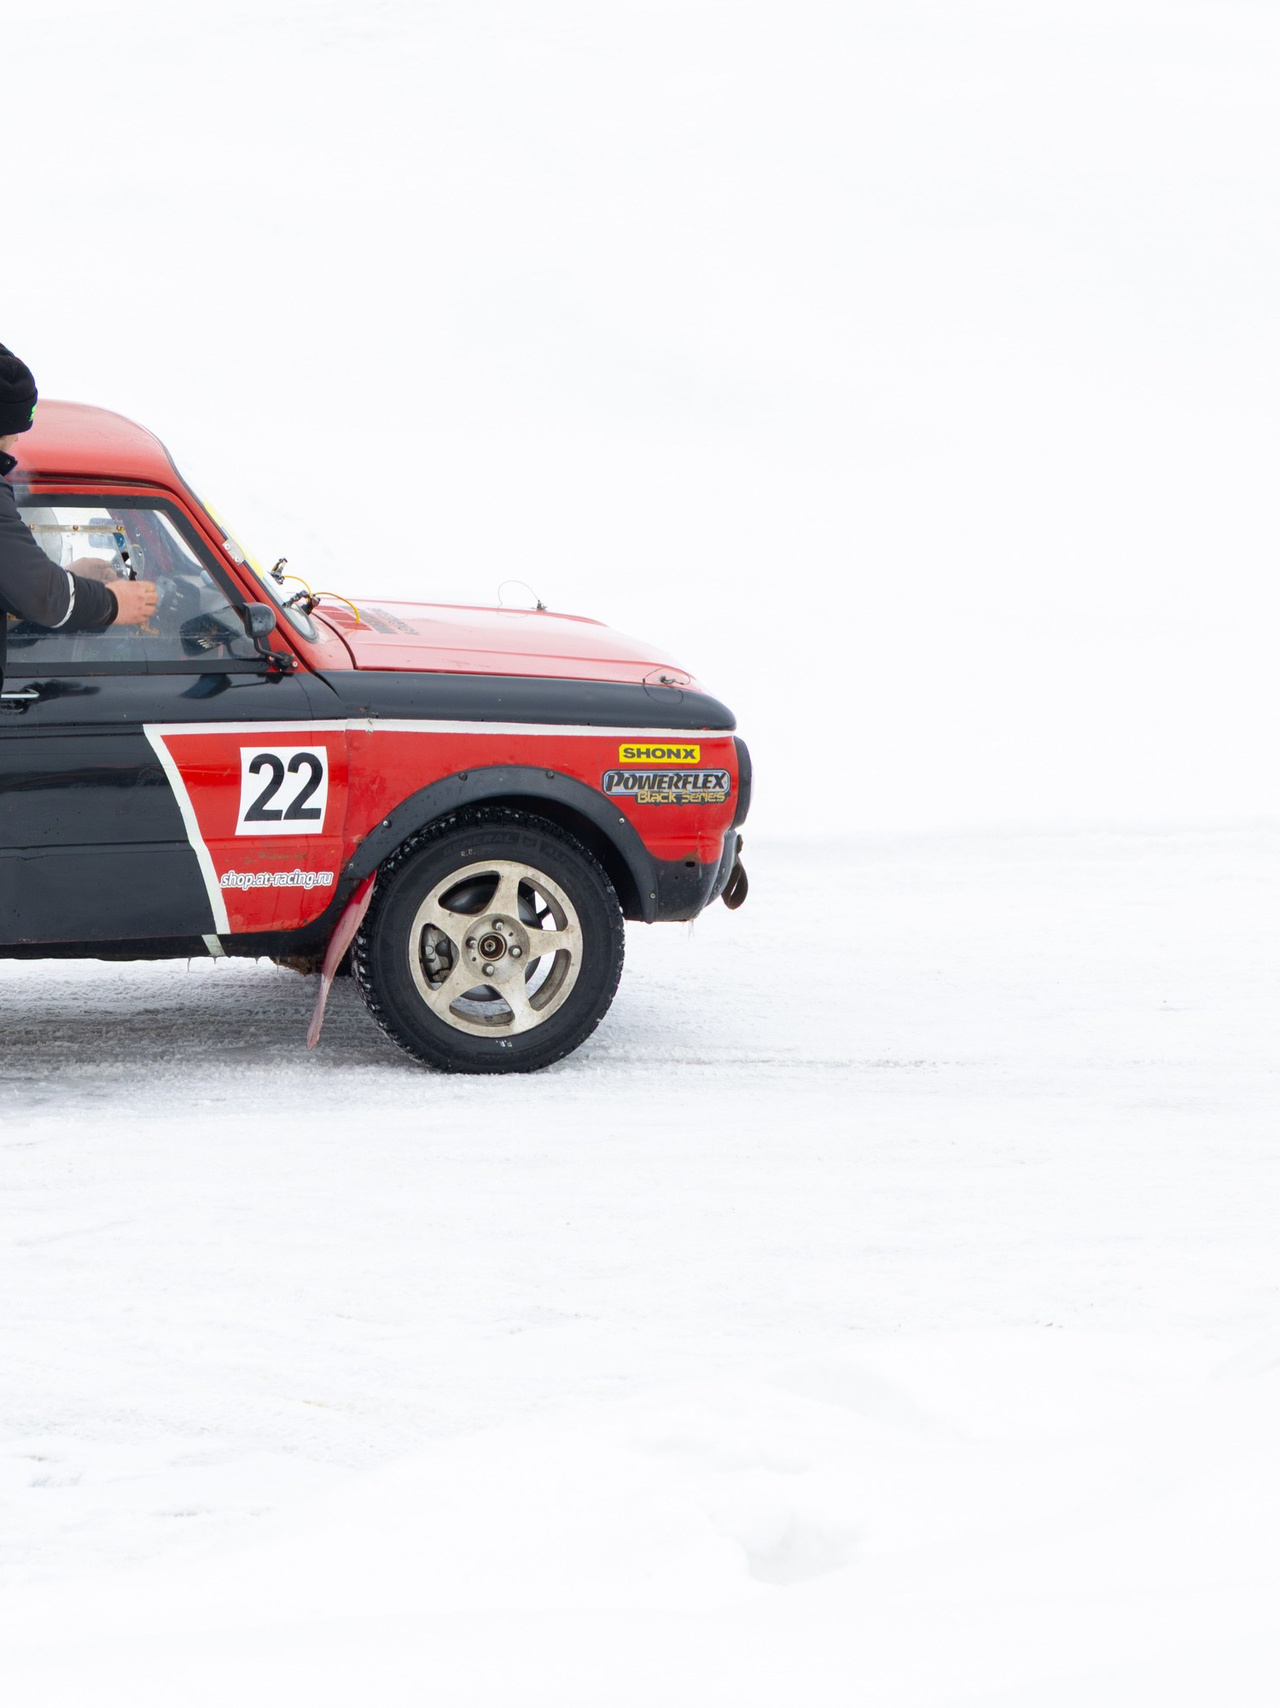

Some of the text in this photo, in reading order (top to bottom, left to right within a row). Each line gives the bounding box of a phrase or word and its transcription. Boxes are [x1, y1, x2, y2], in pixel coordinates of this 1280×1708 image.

[623, 747, 697, 760] SHONX
[243, 752, 324, 822] 22
[605, 772, 727, 792] POWERFLEX
[637, 789, 726, 803] Black Series
[221, 870, 333, 890] shop.at-racing.ru
